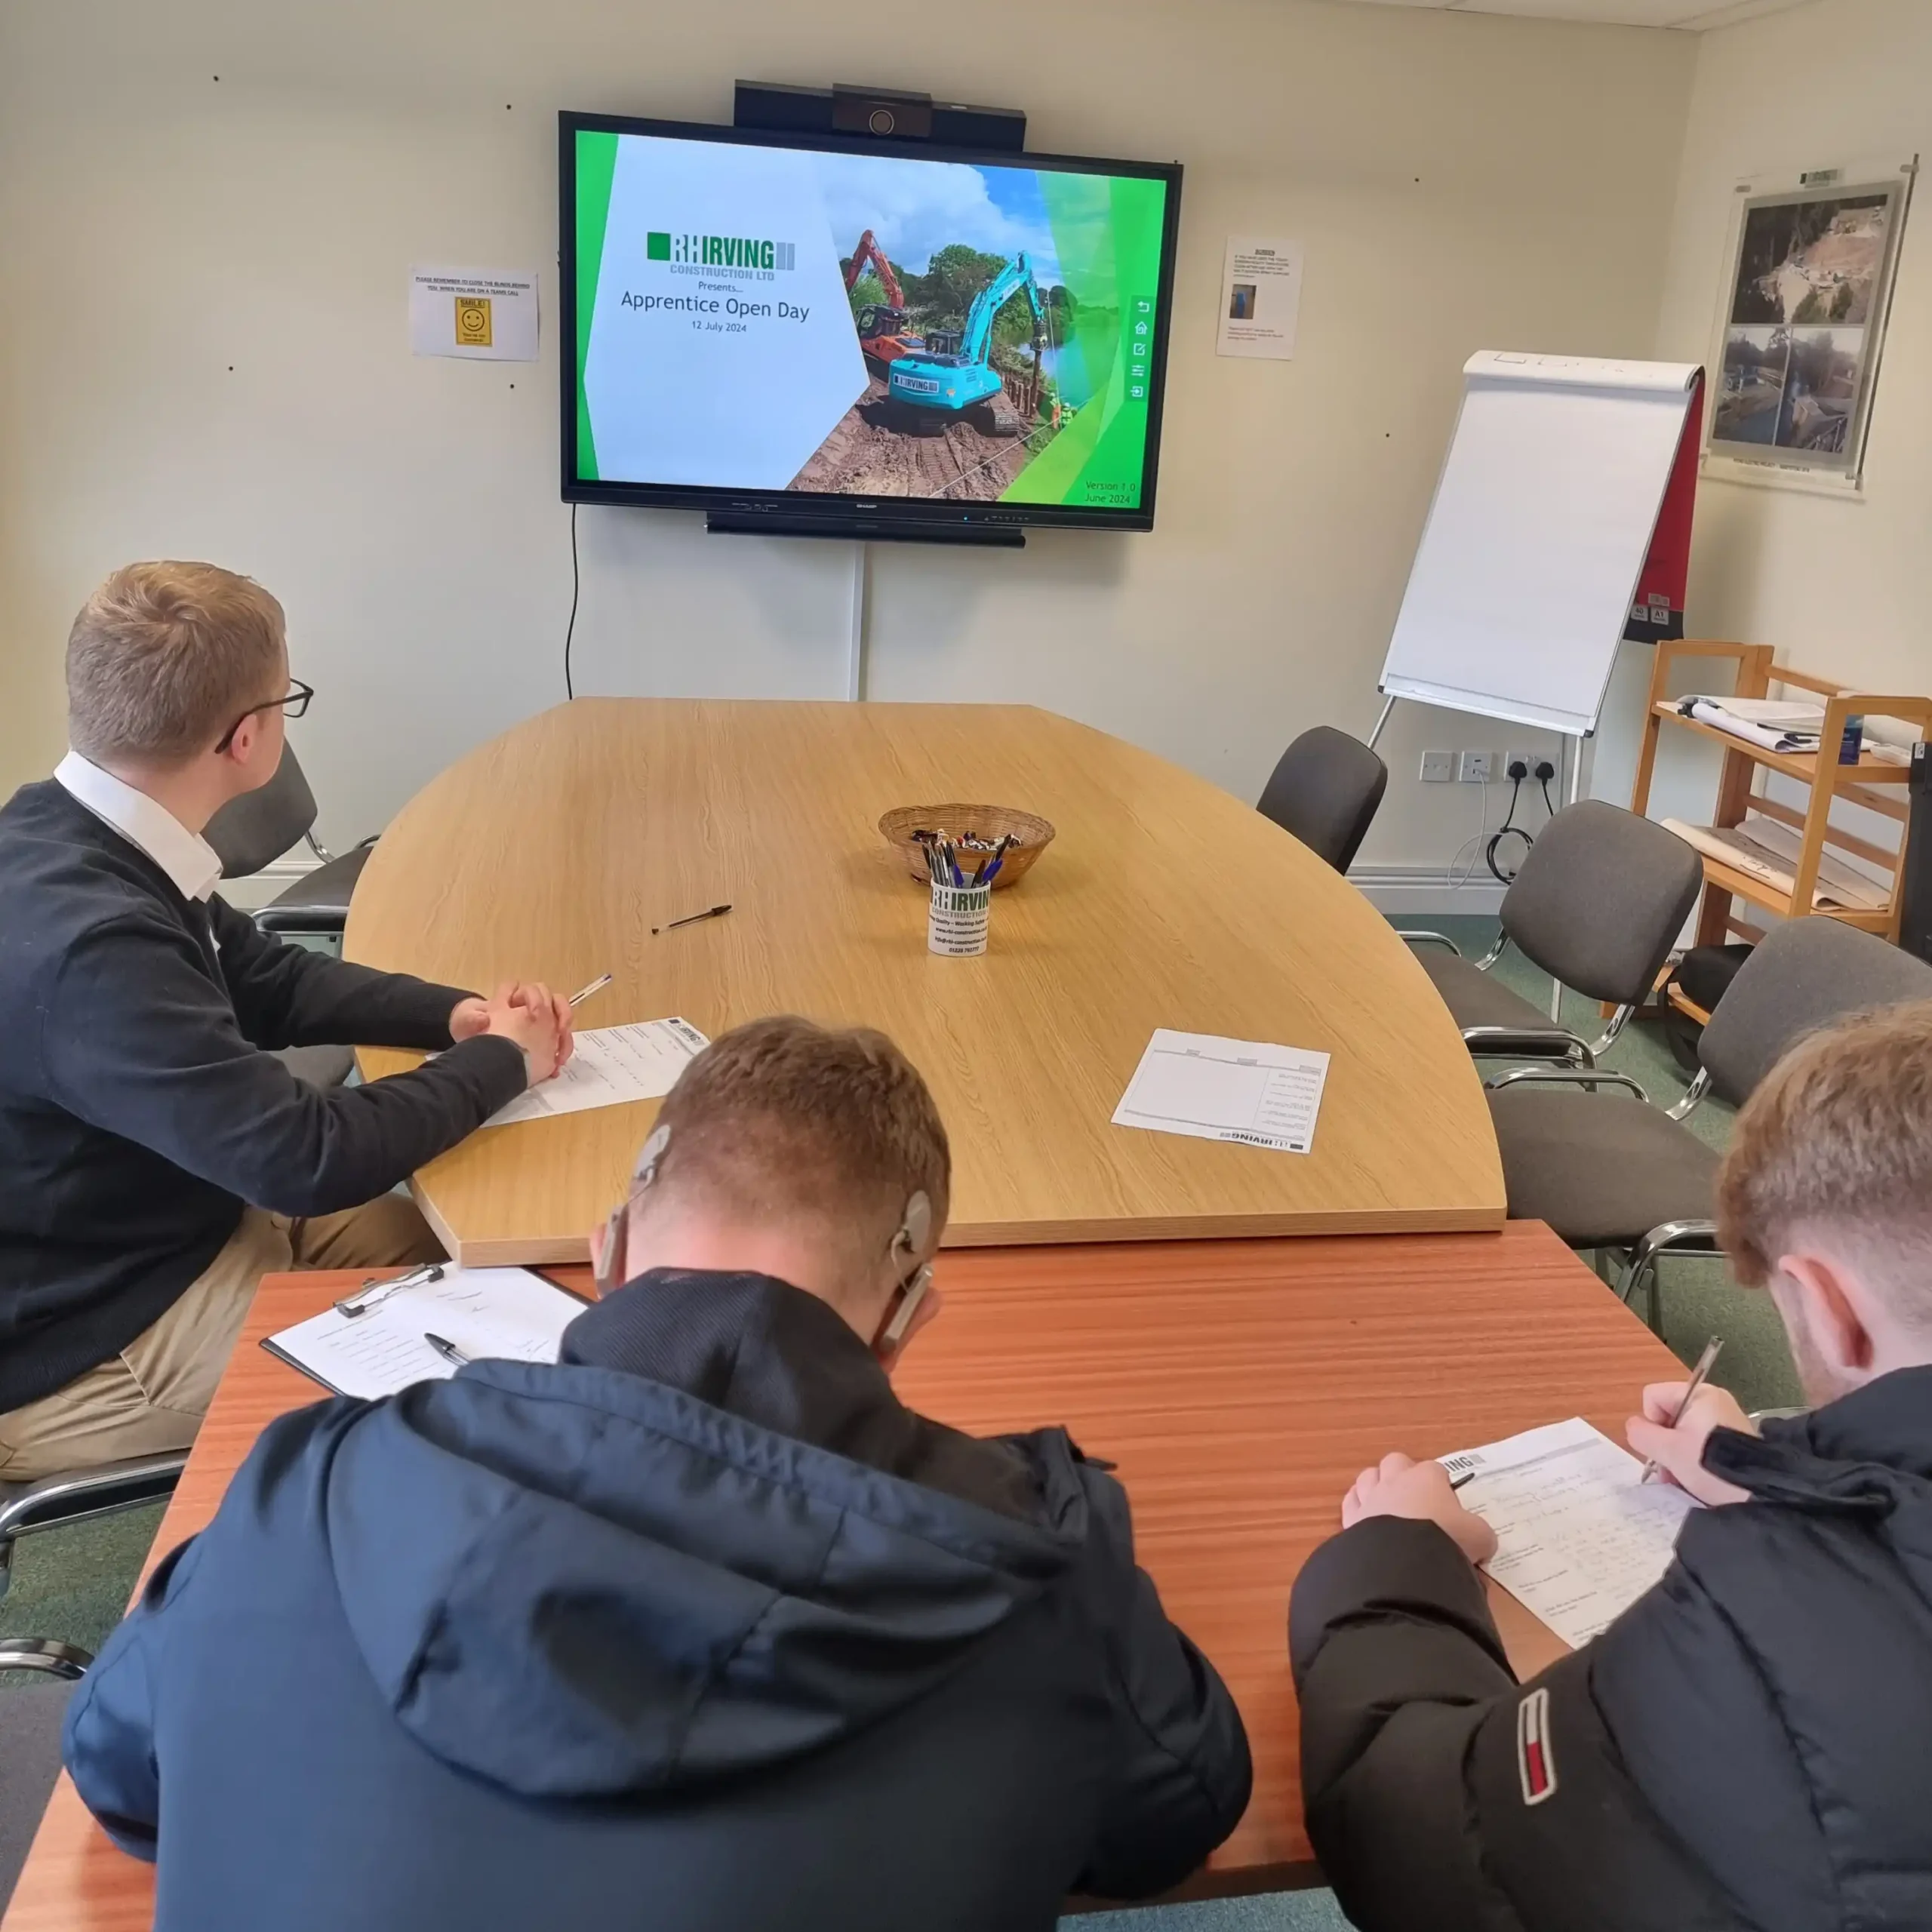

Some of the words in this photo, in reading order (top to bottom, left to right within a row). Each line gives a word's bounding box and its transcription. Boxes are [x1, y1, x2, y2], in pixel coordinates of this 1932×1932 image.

[670, 264, 753, 280] CONSTRUCTION
[756, 270, 775, 281] LTD
[621, 291, 720, 313] Apprentice
[726, 298, 771, 318] Open
[778, 302, 810, 323] Day
[692, 321, 702, 330] 12
[705, 321, 723, 333] July
[725, 323, 747, 332] 2024
[1085, 480, 1118, 491] Version
[1084, 493, 1106, 503] June
[1109, 494, 1131, 503] 2024
